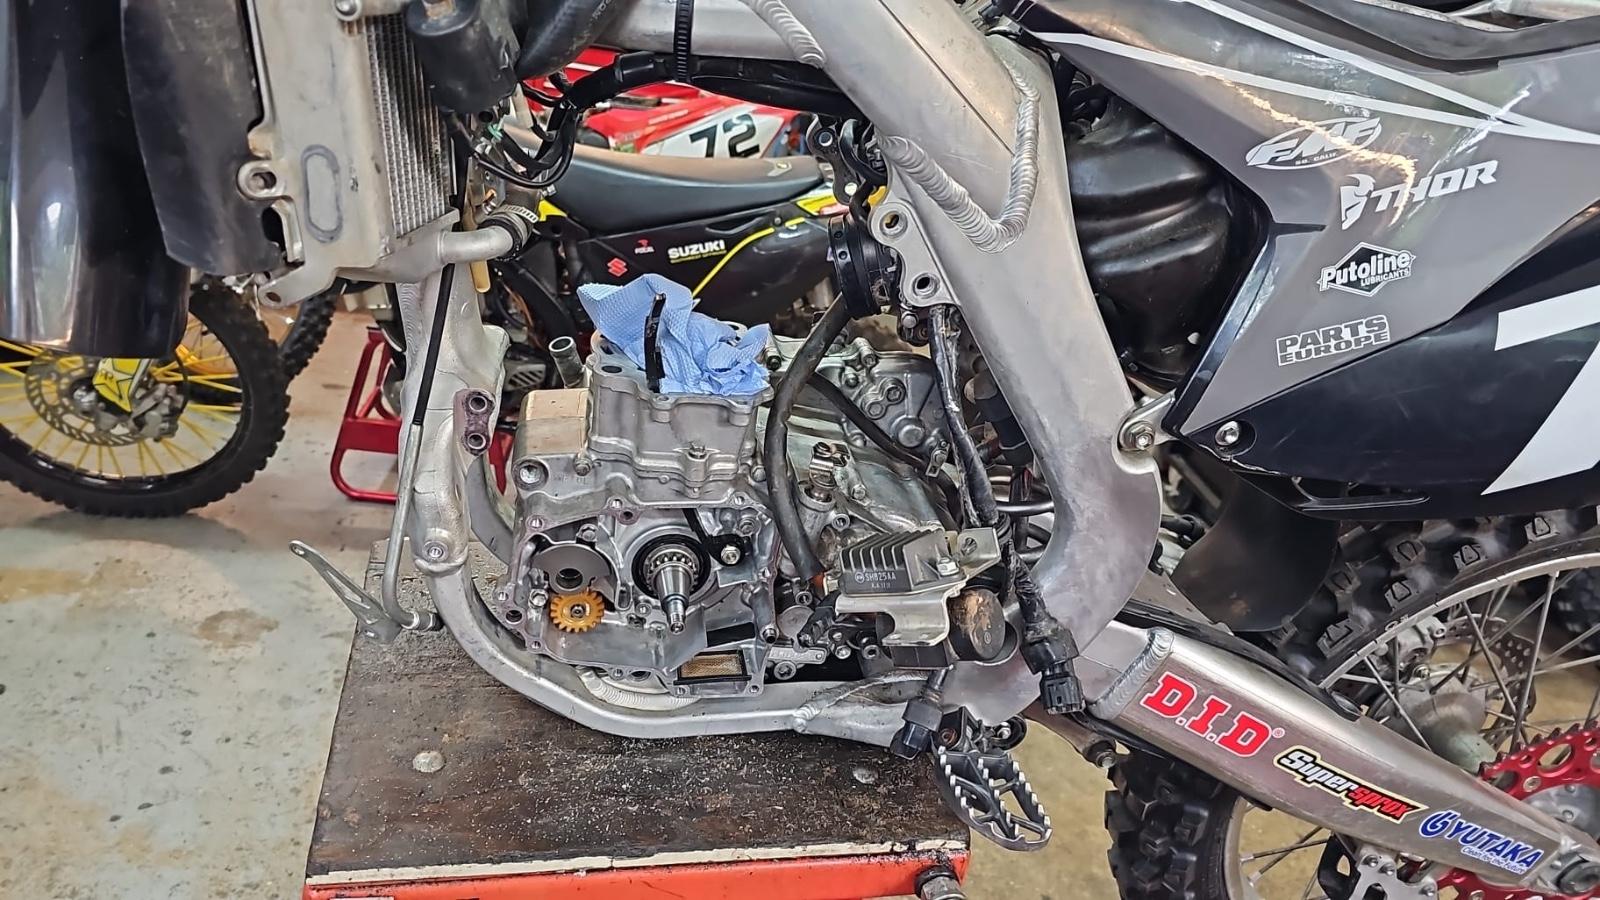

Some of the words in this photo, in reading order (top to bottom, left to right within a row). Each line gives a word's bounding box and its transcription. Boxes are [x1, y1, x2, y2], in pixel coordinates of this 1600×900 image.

[689, 113, 760, 158] 72
[1246, 117, 1382, 167] FMF
[1370, 160, 1499, 213] THOR
[667, 239, 726, 260] SUZUKI
[1320, 251, 1411, 291] Putoline
[1360, 268, 1410, 287] LUBRICANTS
[1277, 315, 1387, 355] PARTS
[1279, 331, 1389, 364] EUROPE
[1279, 748, 1414, 819] Supersprox
[1444, 819, 1544, 869] YUTAKA
